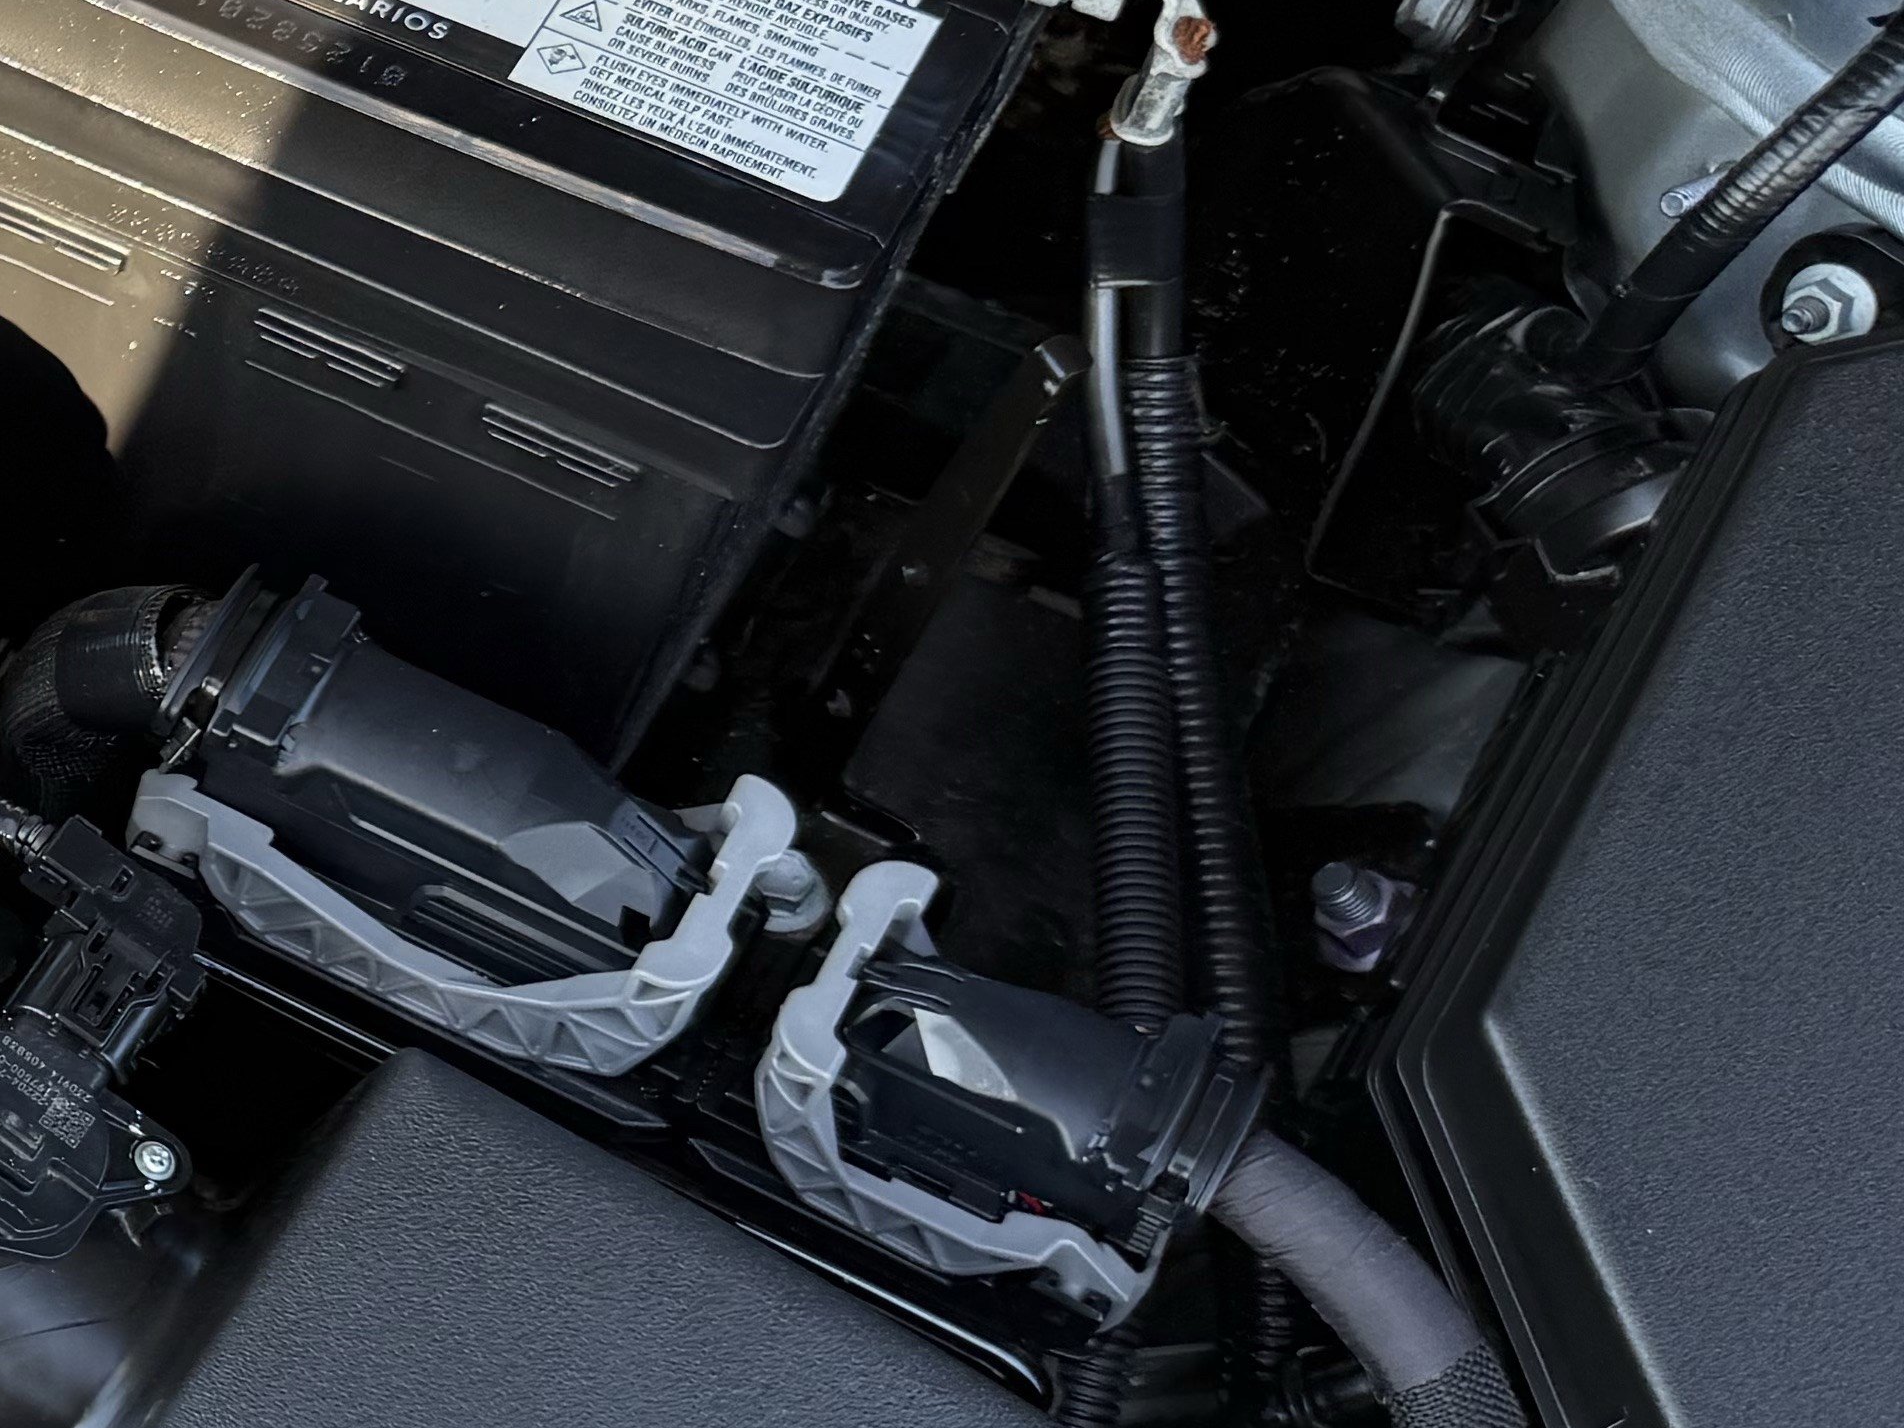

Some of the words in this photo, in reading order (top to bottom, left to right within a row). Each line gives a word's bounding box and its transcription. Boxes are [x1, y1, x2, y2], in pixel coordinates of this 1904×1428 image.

[801, 8, 874, 43] EXPLOSIFS
[828, 3, 847, 17] OR
[871, 4, 917, 29] GASES
[607, 37, 626, 50] OR
[625, 44, 669, 67] SEVERE
[613, 25, 653, 47] CAUSE
[651, 40, 716, 71] BLINDNESS
[621, 13, 679, 42] SULFURIC
[677, 35, 708, 53] ACID
[706, 46, 733, 63] CAN
[672, 11, 693, 26] LES
[755, 43, 778, 59] LES
[828, 71, 846, 85] DE
[844, 77, 883, 100] FUMER
[762, 28, 819, 58] SMOKING
[579, 77, 622, 101] RINCEZ
[620, 94, 645, 110] LES
[644, 103, 677, 122] YEUX
[587, 65, 613, 81] GET
[612, 74, 668, 103] MEDICAL
[667, 96, 701, 115] HELP
[594, 54, 637, 77] FLUSH
[635, 70, 668, 89] EYES
[667, 82, 749, 121] IMMEDIATELY
[748, 114, 783, 134] WITH
[723, 81, 748, 98] DES
[730, 70, 758, 87] PEUT
[756, 80, 798, 103] CAUSER
[797, 96, 812, 109] LA
[845, 115, 863, 128] OU
[737, 58, 787, 84] L'ACIDE
[785, 76, 865, 114] SULFURIQUE
[571, 89, 638, 122] CONSULTEZ
[636, 114, 657, 129] UN
